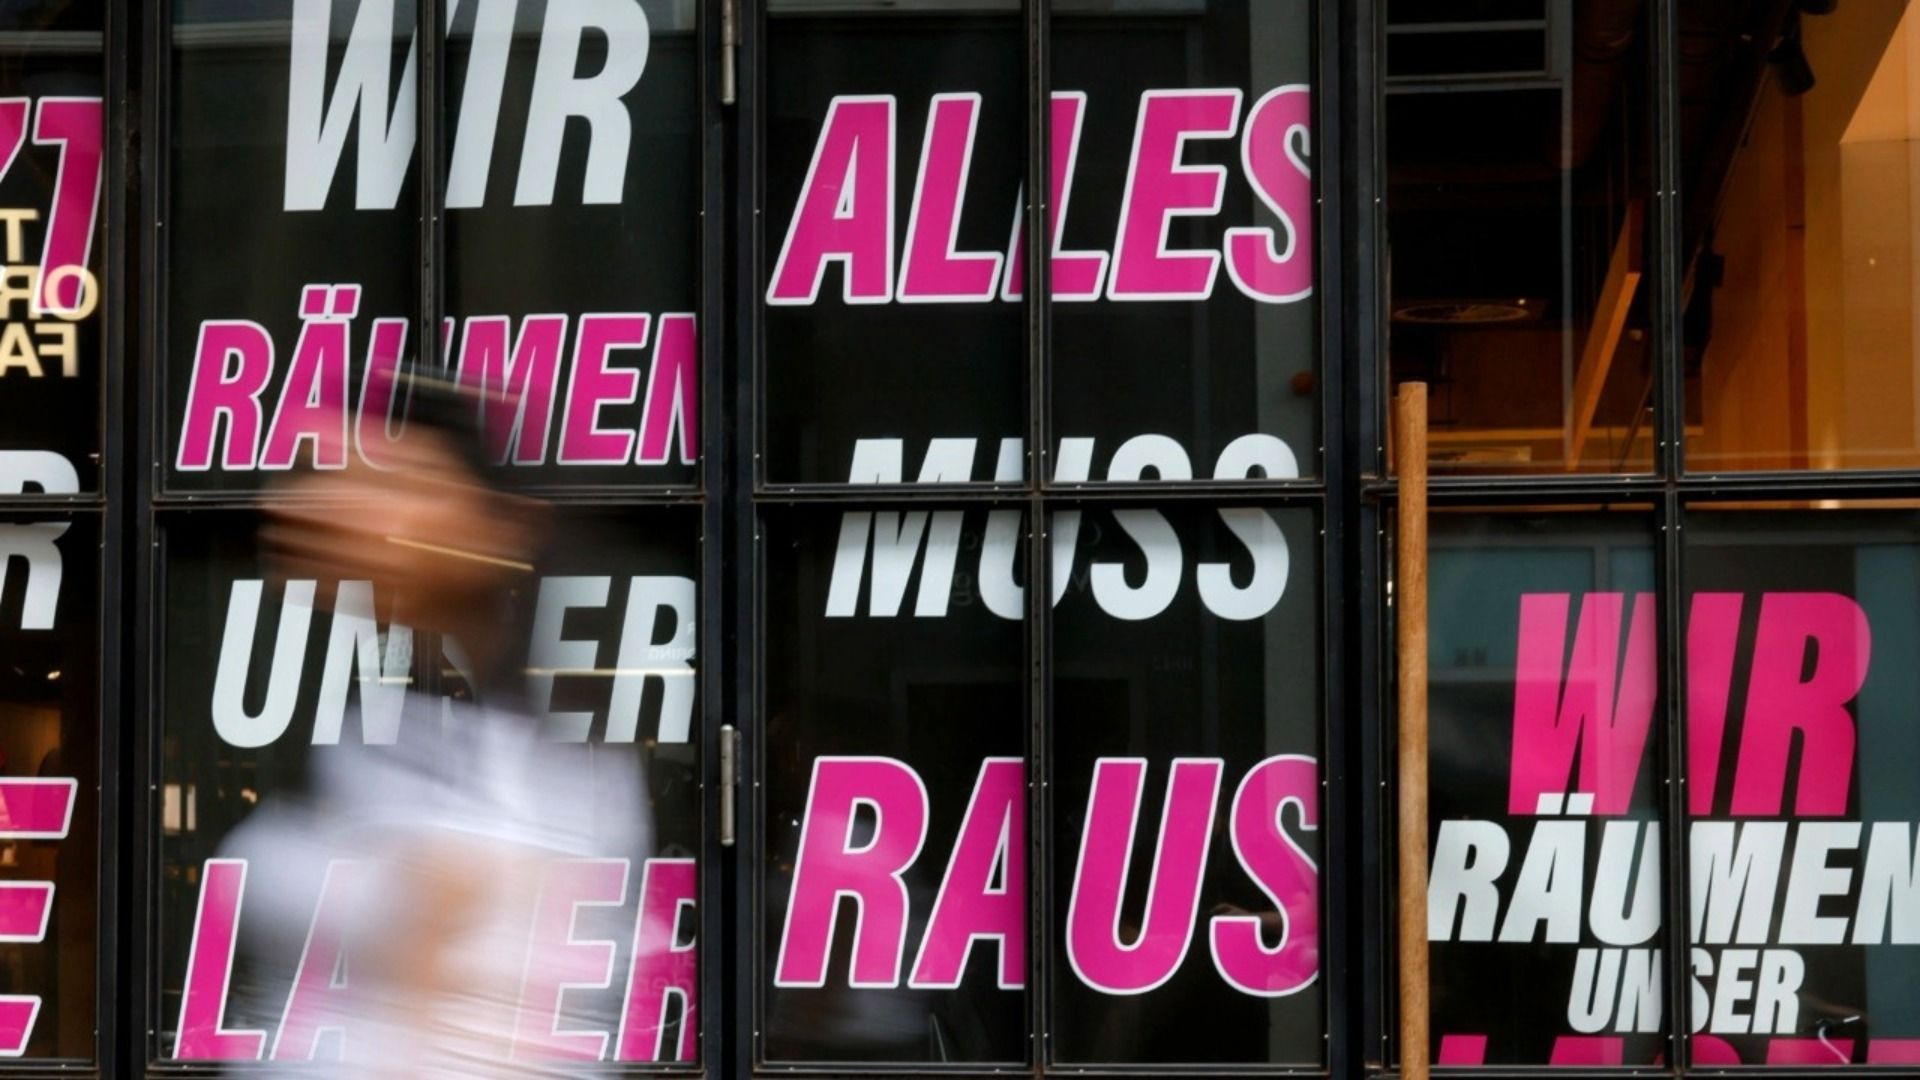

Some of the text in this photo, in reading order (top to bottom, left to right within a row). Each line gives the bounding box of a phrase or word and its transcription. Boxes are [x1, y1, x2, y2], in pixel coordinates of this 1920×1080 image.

[283, 0, 650, 211] WIR
[766, 83, 1313, 306] ALLES
[824, 433, 1300, 621] MUSS
[1507, 591, 1872, 817] WIR
[173, 857, 697, 1062] LAER
[773, 754, 1319, 998] RAUS
